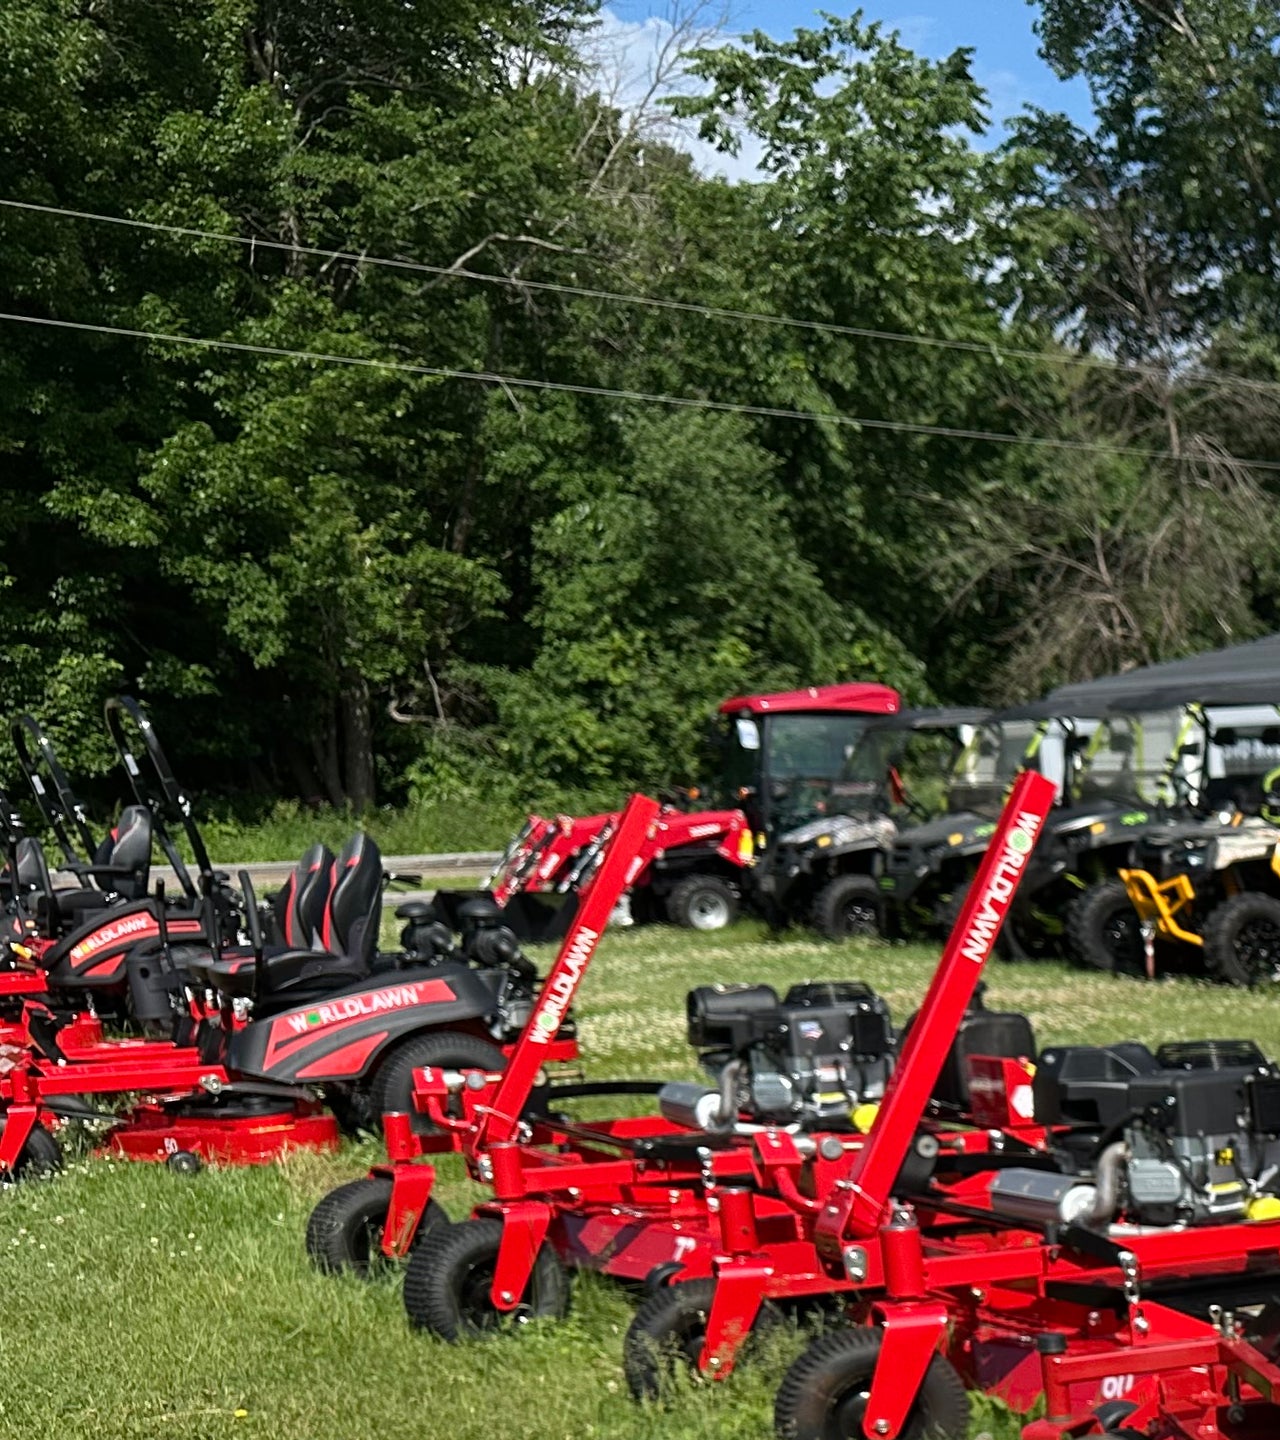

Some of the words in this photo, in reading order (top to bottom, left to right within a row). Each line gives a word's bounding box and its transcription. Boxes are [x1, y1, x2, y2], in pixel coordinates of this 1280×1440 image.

[961, 811, 1042, 964] WORLDLAWN
[287, 985, 420, 1034] WORLDLAWN
[528, 926, 599, 1045] WORLDLAWN
